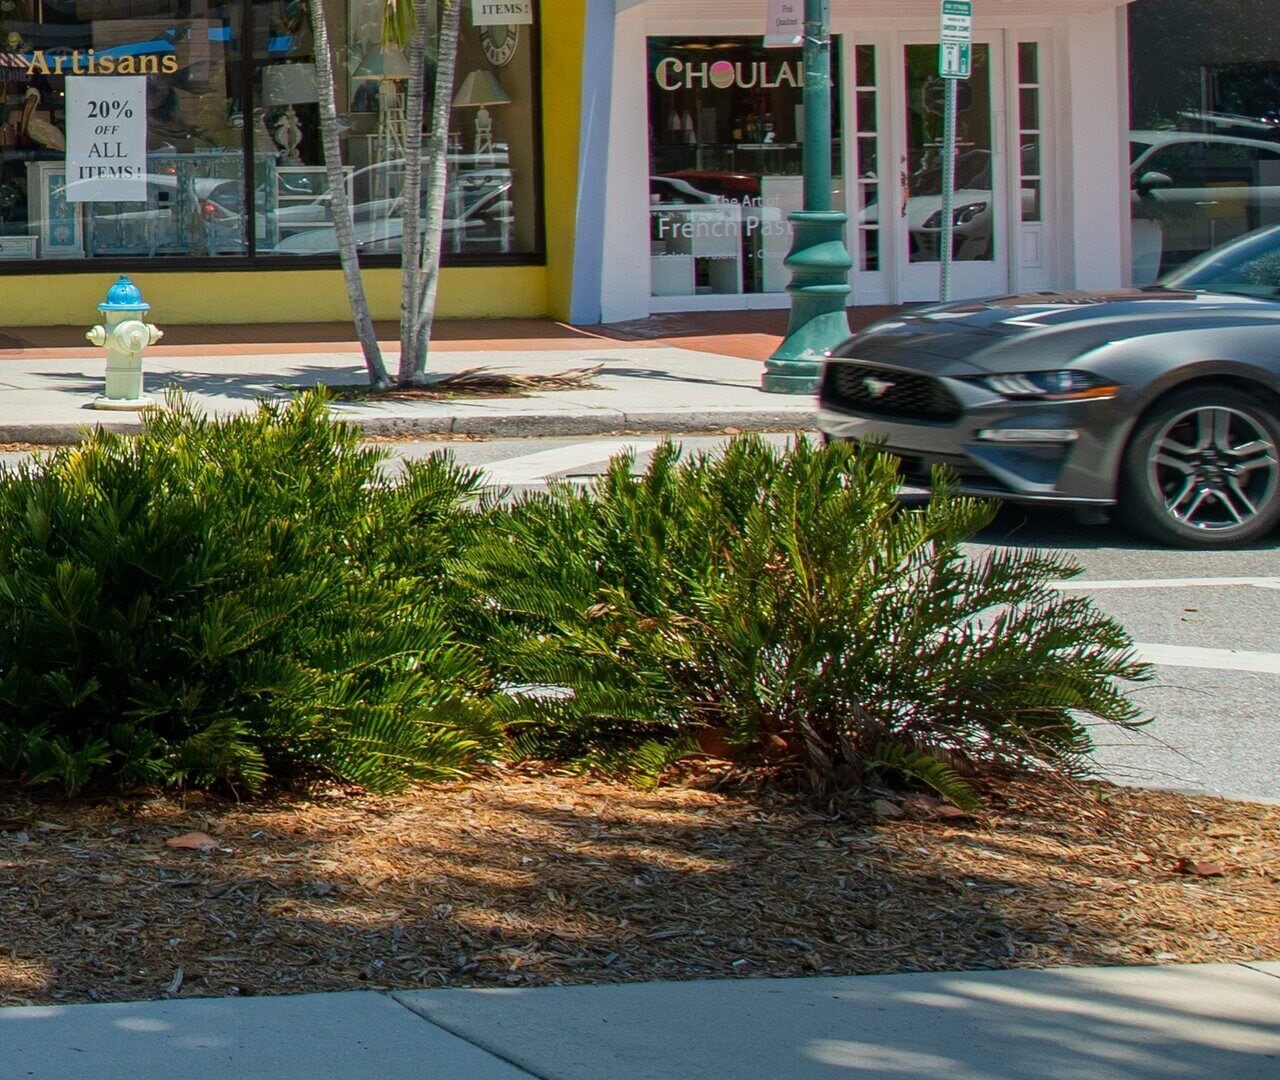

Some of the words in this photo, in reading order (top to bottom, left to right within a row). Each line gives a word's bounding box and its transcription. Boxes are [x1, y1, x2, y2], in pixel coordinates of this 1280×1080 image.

[26, 48, 179, 75] Artisans
[655, 57, 834, 91] CHOULAL
[87, 100, 133, 119] 20%
[94, 125, 120, 135] OFF
[87, 142, 128, 158] ALL
[742, 195, 762, 207] Art
[658, 215, 738, 239] French
[746, 215, 794, 237] Past
